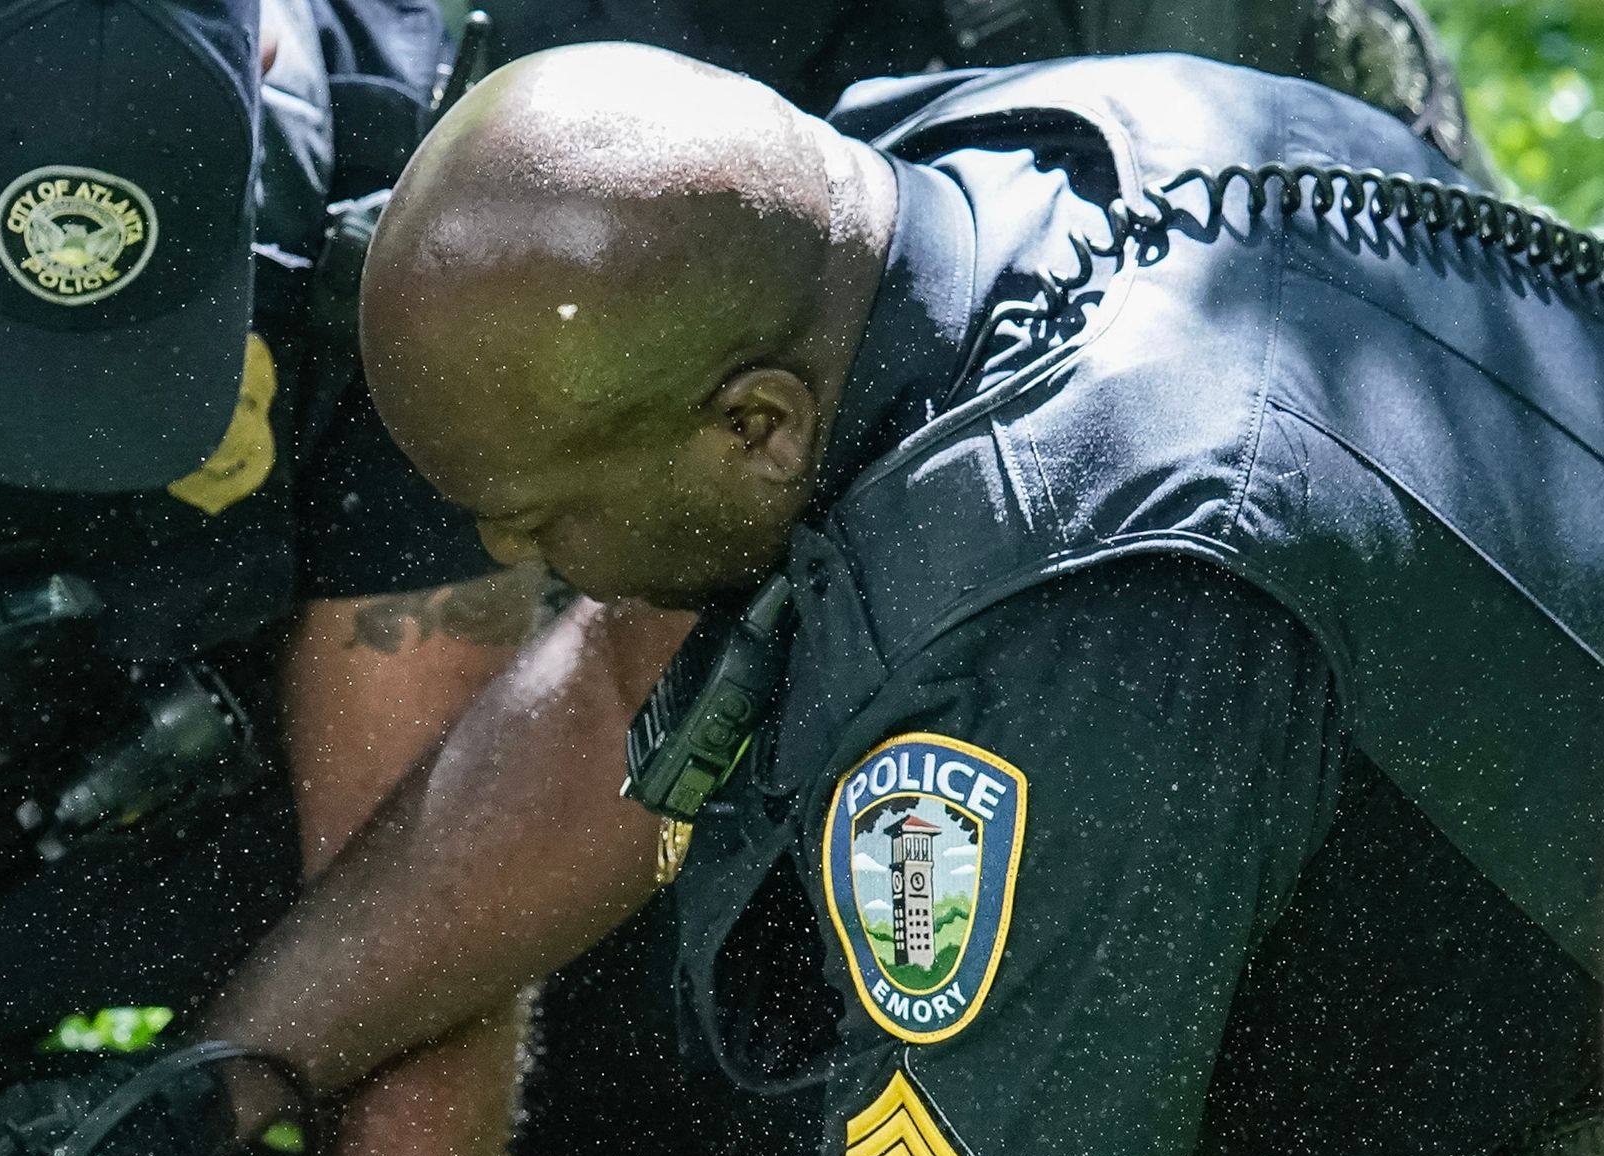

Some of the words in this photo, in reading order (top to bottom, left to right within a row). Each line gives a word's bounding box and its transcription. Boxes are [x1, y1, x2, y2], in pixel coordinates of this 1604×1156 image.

[7, 191, 38, 234] CITY
[37, 179, 70, 201] OF
[74, 182, 144, 246] ATLANTA
[20, 256, 120, 294] POLICE
[846, 752, 1007, 820] POLICE
[870, 979, 967, 1023] EMORY
